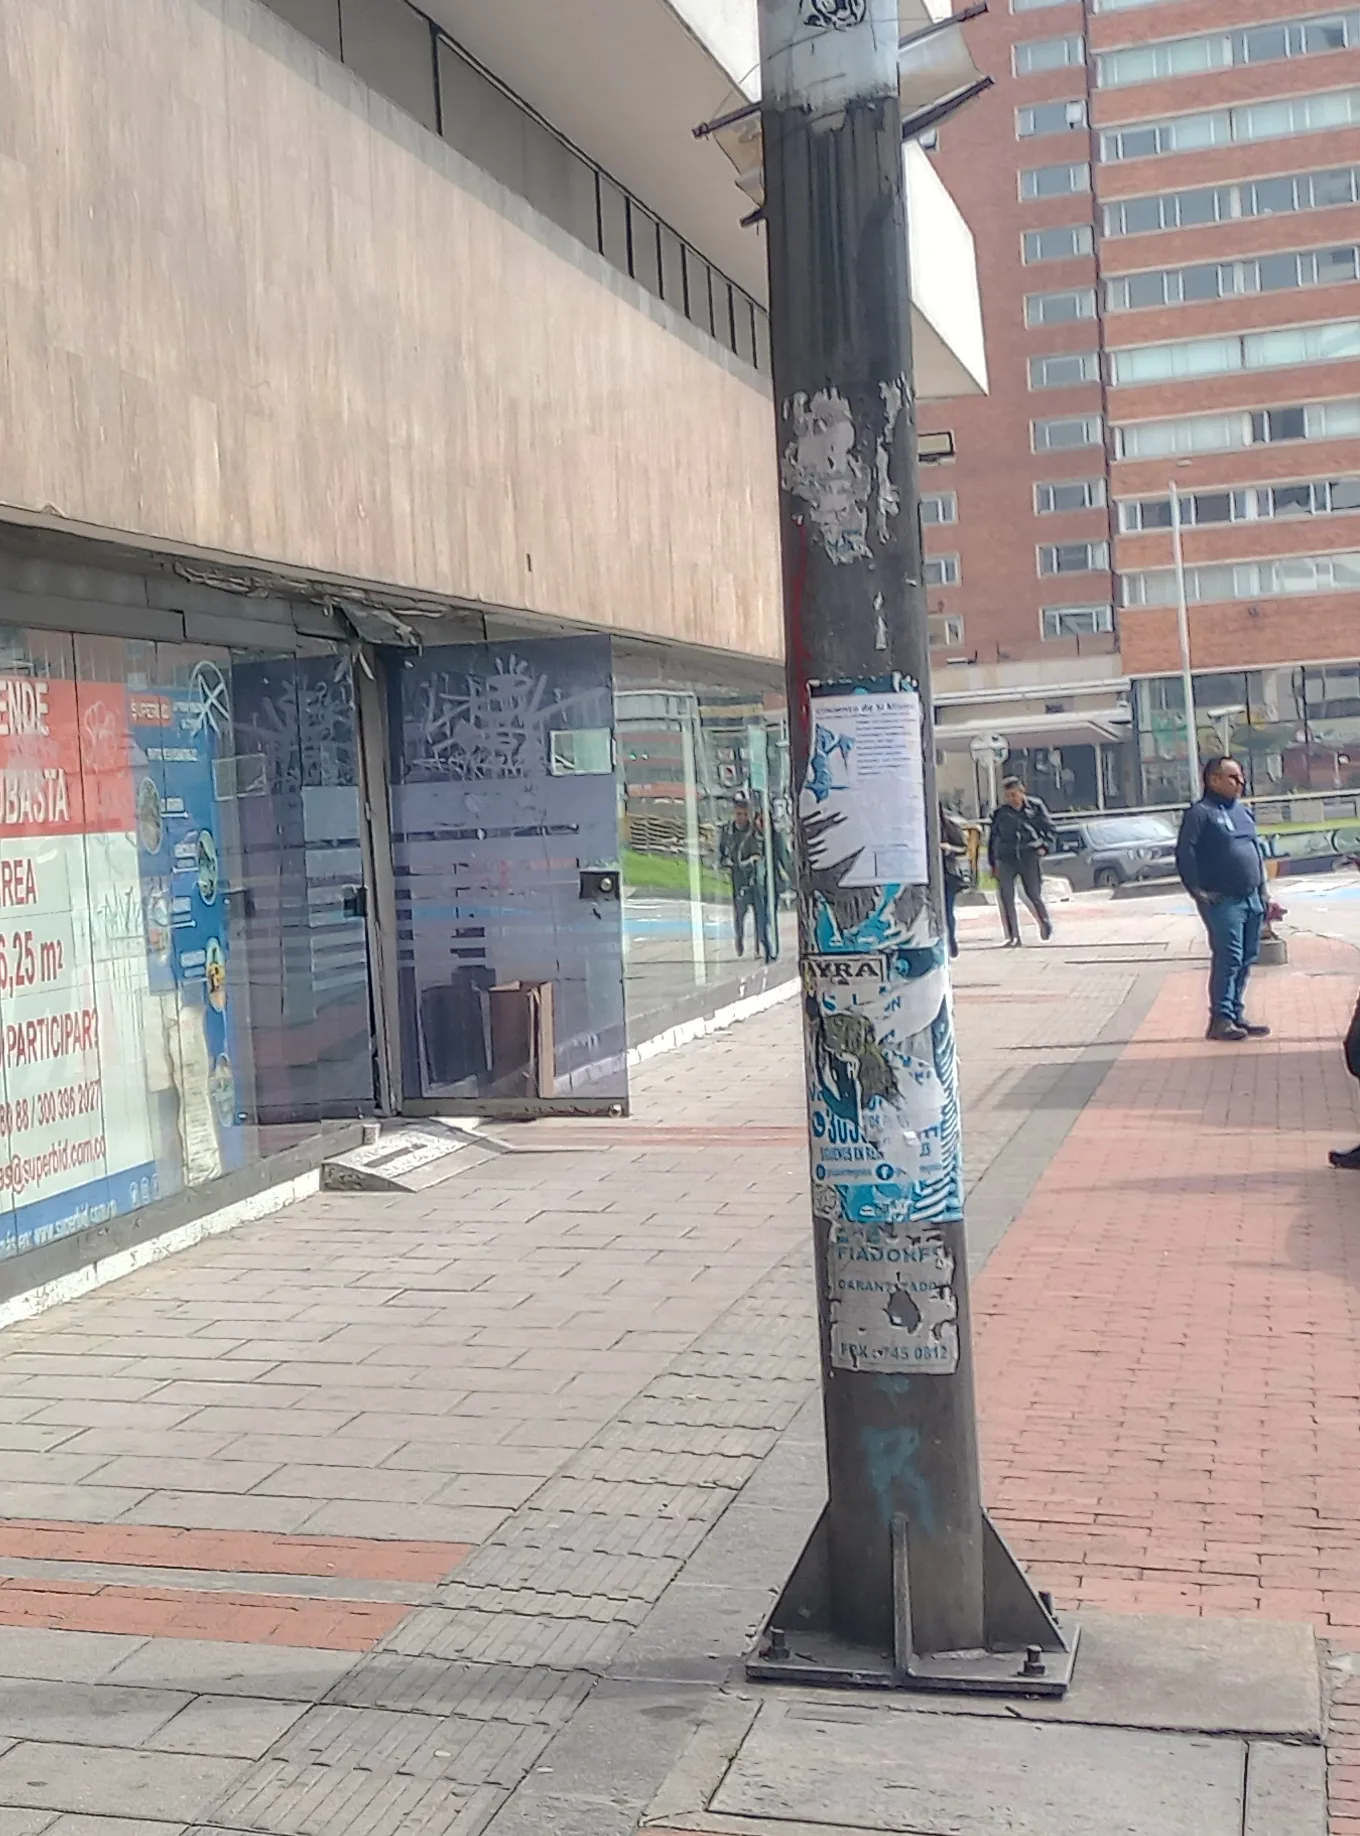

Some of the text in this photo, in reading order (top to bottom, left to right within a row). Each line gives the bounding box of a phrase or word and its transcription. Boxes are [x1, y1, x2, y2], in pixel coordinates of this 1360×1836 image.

[6, 1007, 99, 1068] PARTICIPAR?
[15, 1098, 29, 1133] 88
[37, 1091, 56, 1126] 300
[58, 1086, 75, 1120] 396
